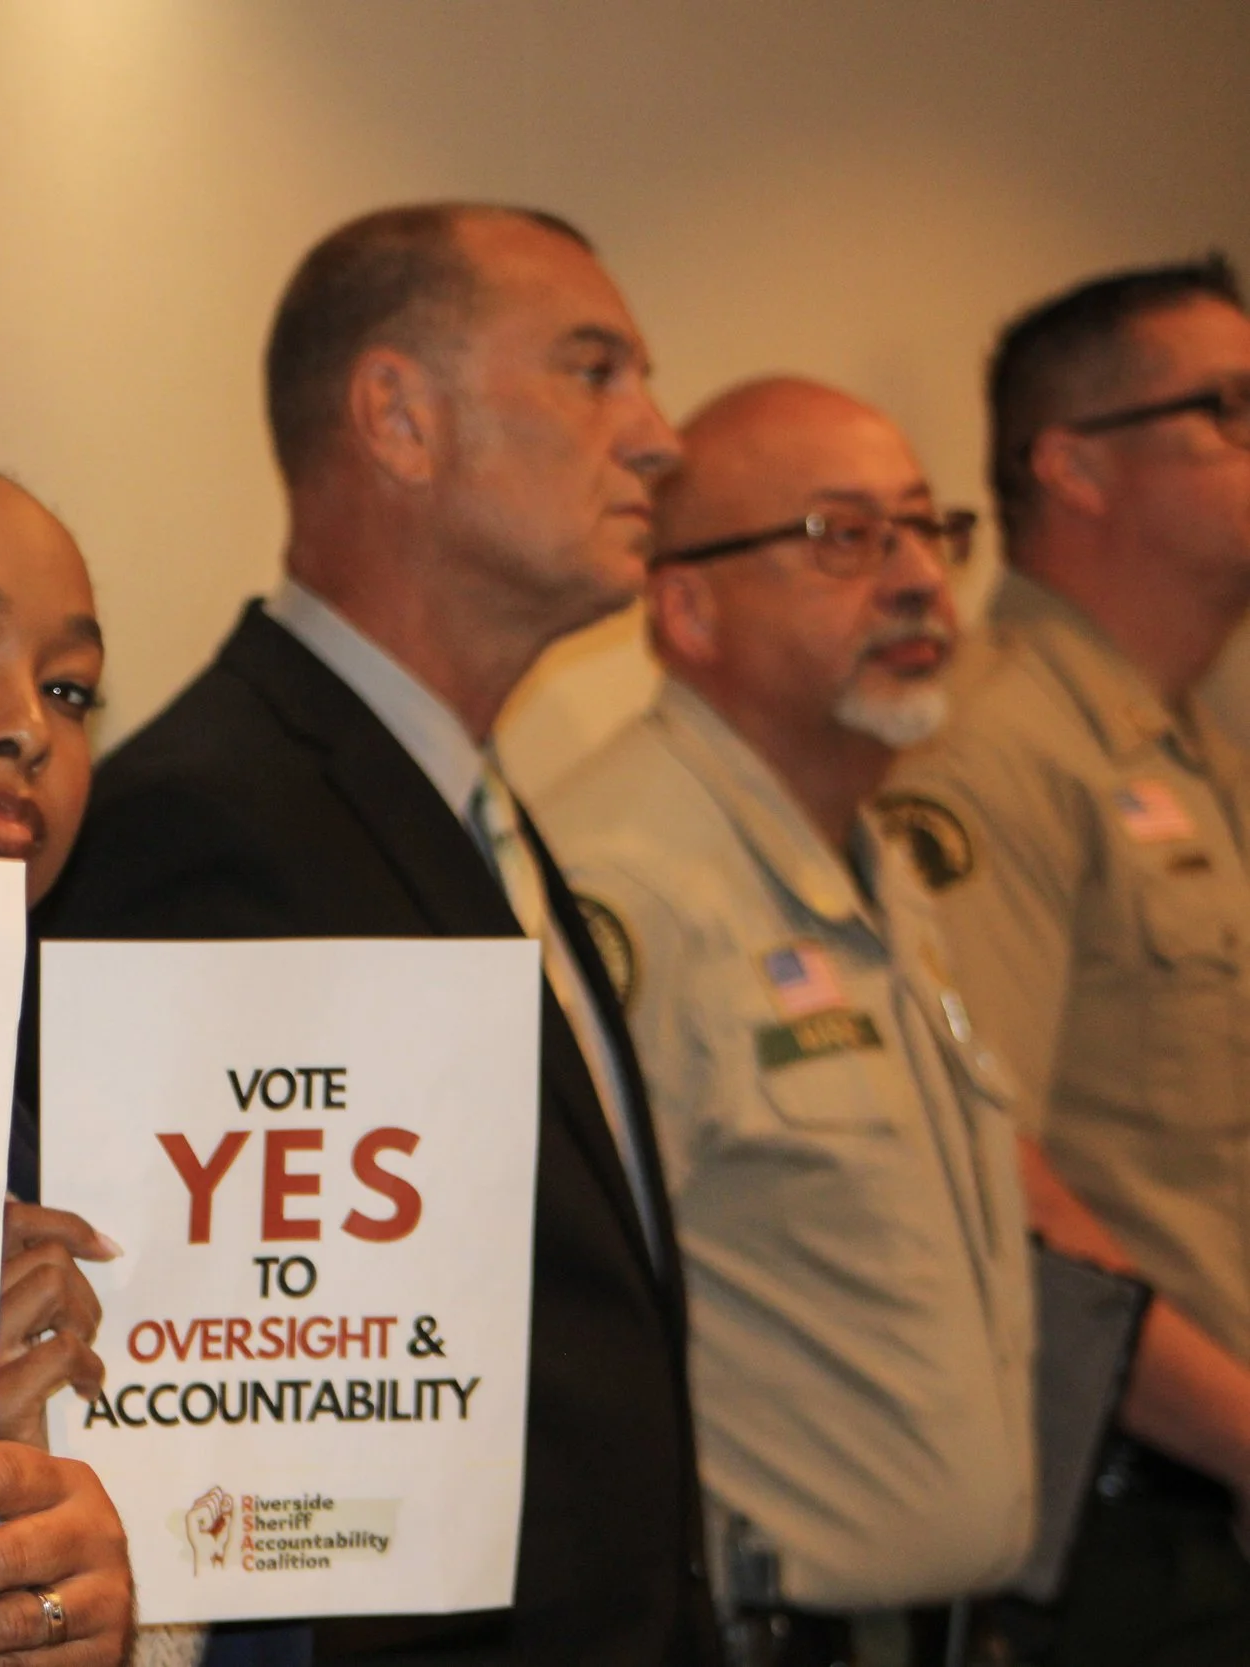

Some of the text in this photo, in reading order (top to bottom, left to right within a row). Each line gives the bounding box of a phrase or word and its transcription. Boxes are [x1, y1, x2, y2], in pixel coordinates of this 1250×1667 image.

[227, 1066, 348, 1112] VOTE
[155, 1126, 424, 1245] YES
[253, 1256, 317, 1299] TO
[127, 1314, 447, 1364] OVERSIGHT &
[83, 1377, 481, 1429] ACCOUNTABILITY
[241, 1494, 335, 1513] Riverside
[242, 1512, 312, 1532] Sheriff
[241, 1532, 390, 1553] Accountability
[241, 1553, 332, 1571] Coalition
